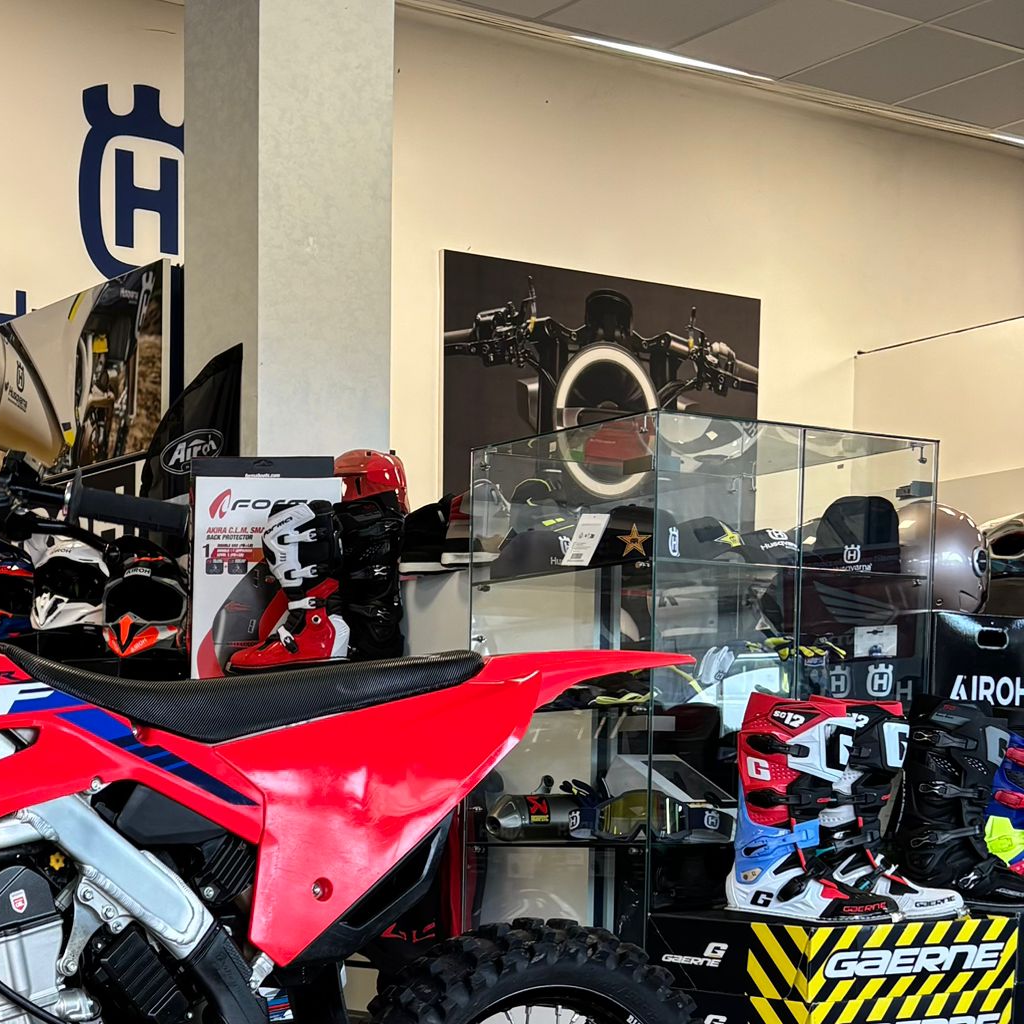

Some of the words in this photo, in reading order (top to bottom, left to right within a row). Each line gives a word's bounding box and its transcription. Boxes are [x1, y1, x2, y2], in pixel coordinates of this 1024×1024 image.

[207, 526, 227, 534] AKIRA
[126, 567, 151, 576] AIROH
[746, 757, 771, 781] G
[750, 890, 774, 907] G
[703, 942, 728, 958] G
[661, 953, 722, 968] GAERNE
[824, 942, 1004, 980] GAERNE
